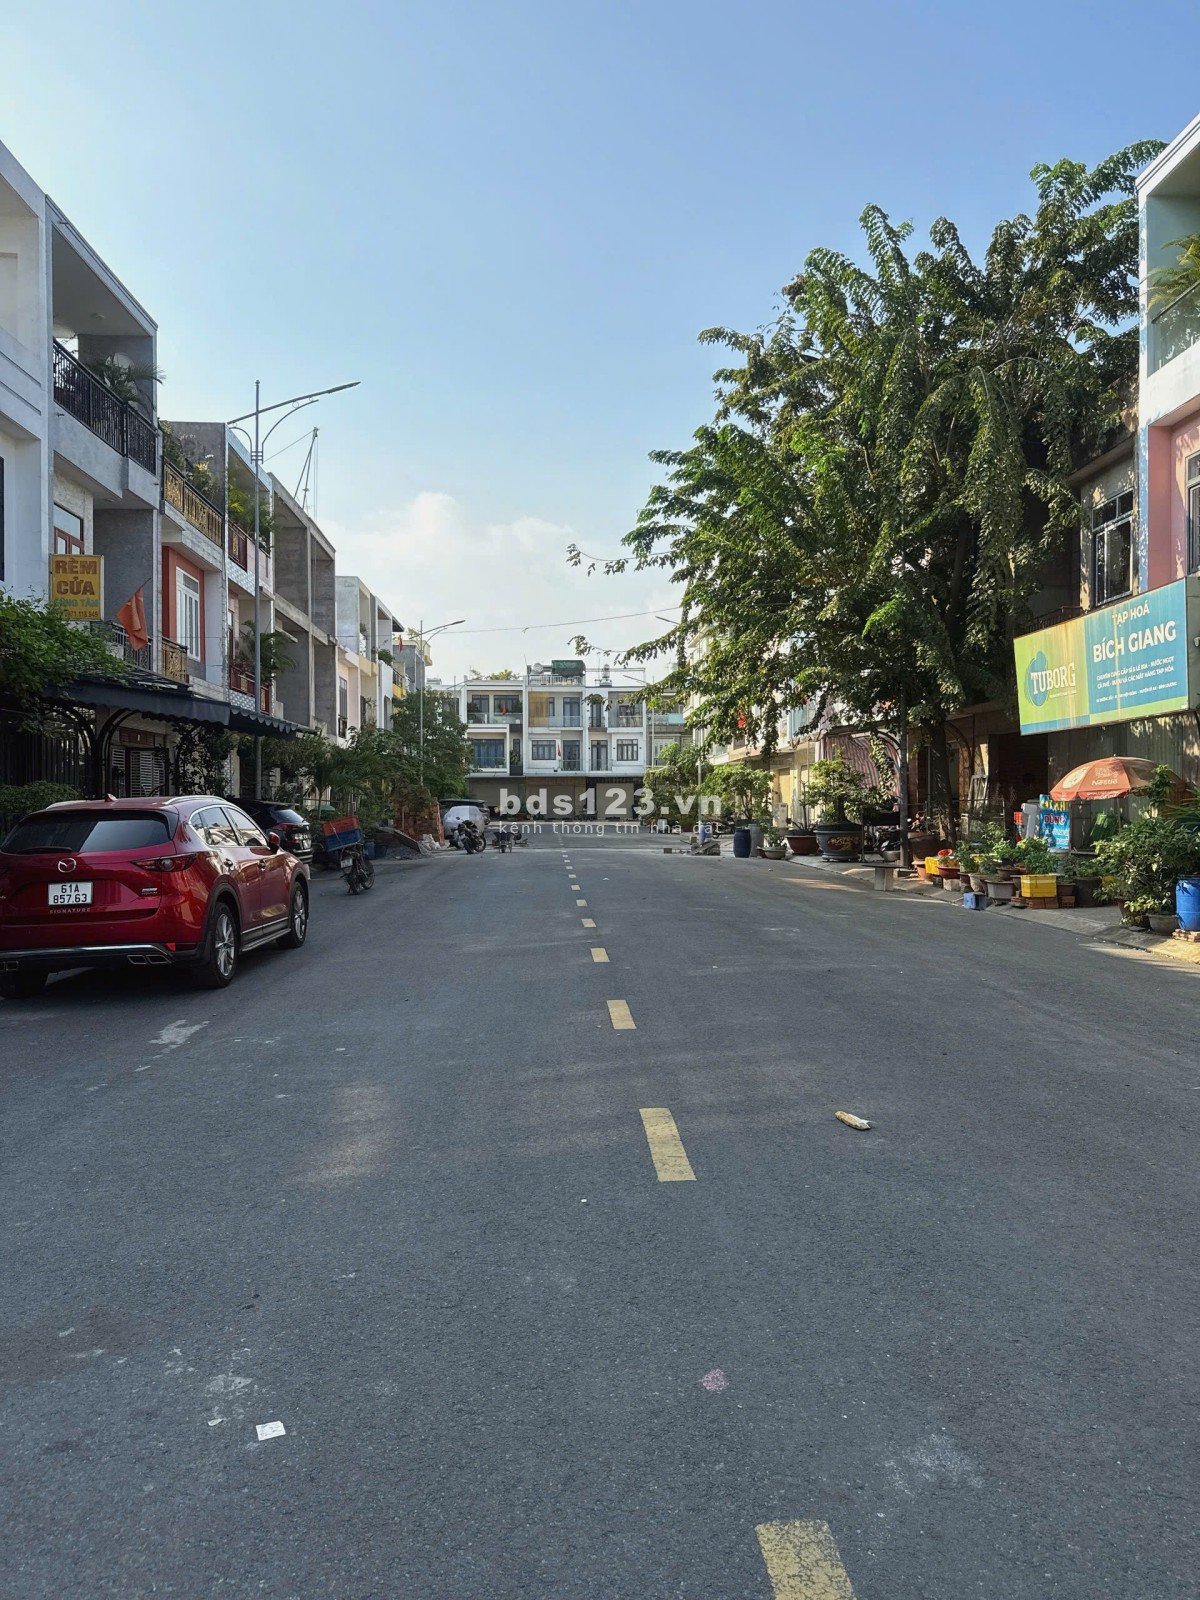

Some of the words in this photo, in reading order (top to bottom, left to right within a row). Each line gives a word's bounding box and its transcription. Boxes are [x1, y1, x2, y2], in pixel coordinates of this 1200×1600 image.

[57, 576, 95, 595] CỬA
[1112, 611, 1128, 627] TẠP
[1130, 600, 1151, 620] HOÁ
[1093, 637, 1125, 663] BÍCH
[1128, 620, 1177, 653] GIANG
[1030, 662, 1076, 695] TUBORG
[53, 894, 87, 904] 857.63
[61, 885, 79, 893] 61A
